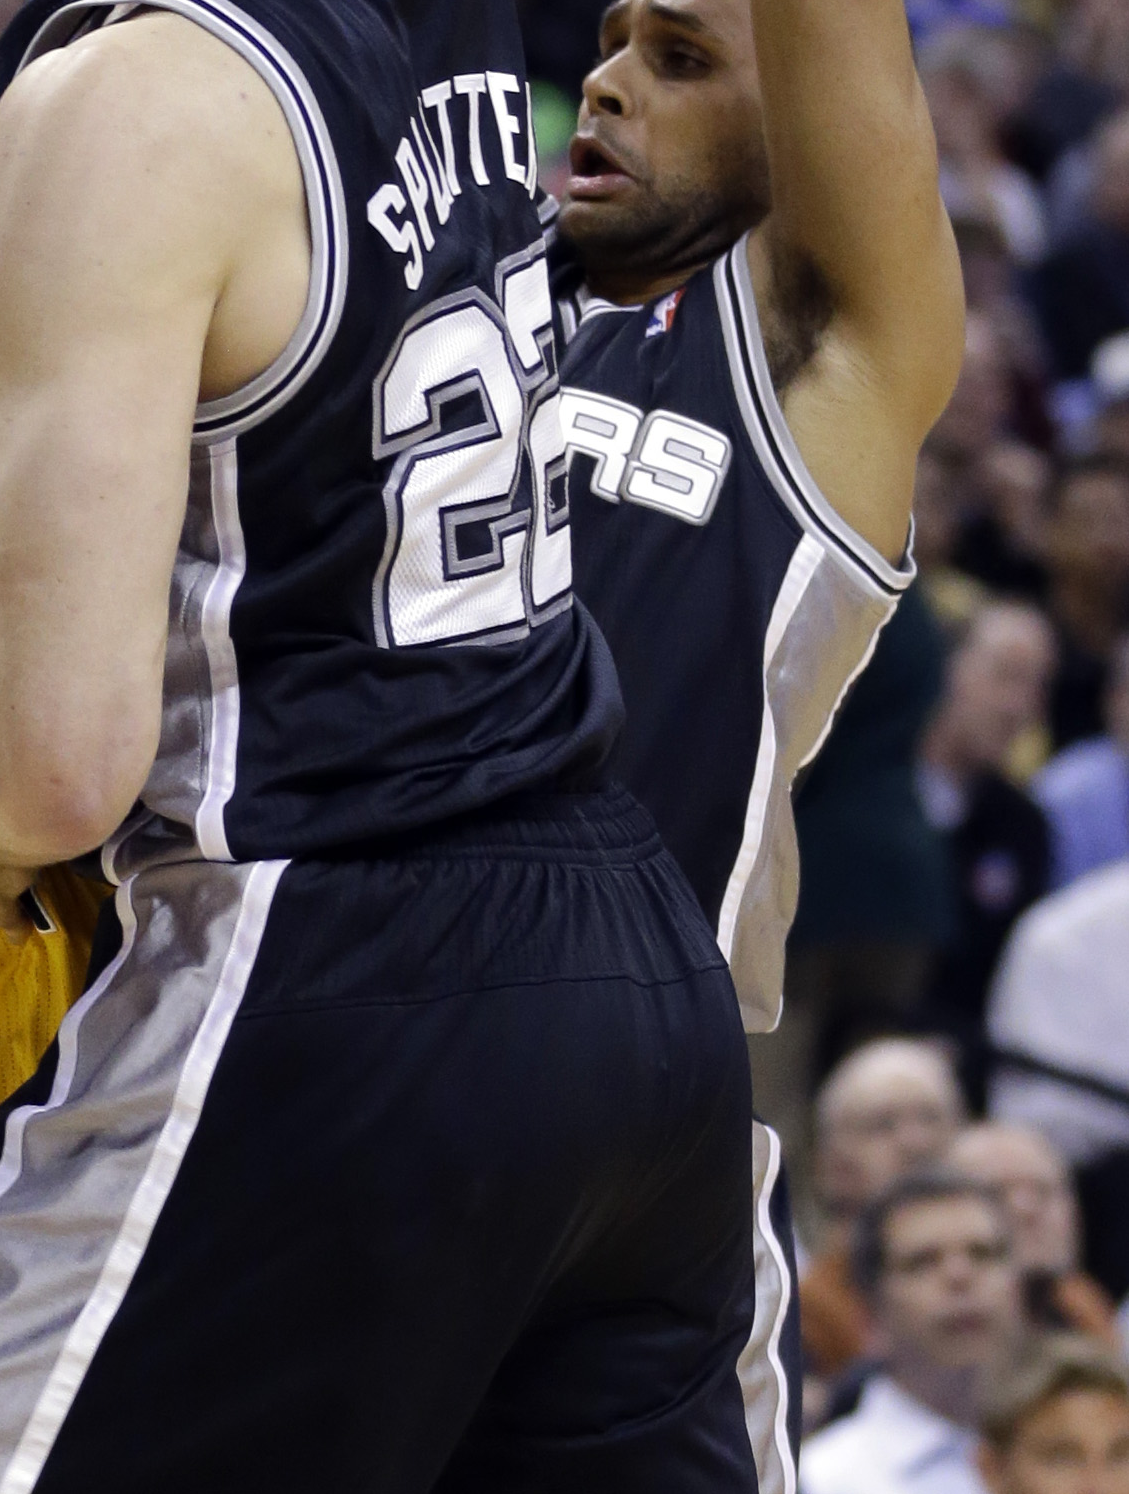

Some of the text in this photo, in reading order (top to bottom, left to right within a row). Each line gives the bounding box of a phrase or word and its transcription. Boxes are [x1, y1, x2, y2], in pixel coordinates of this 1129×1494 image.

[366, 70, 538, 291] SPLITTE
[372, 236, 573, 649] 22
[559, 387, 732, 527] RS
